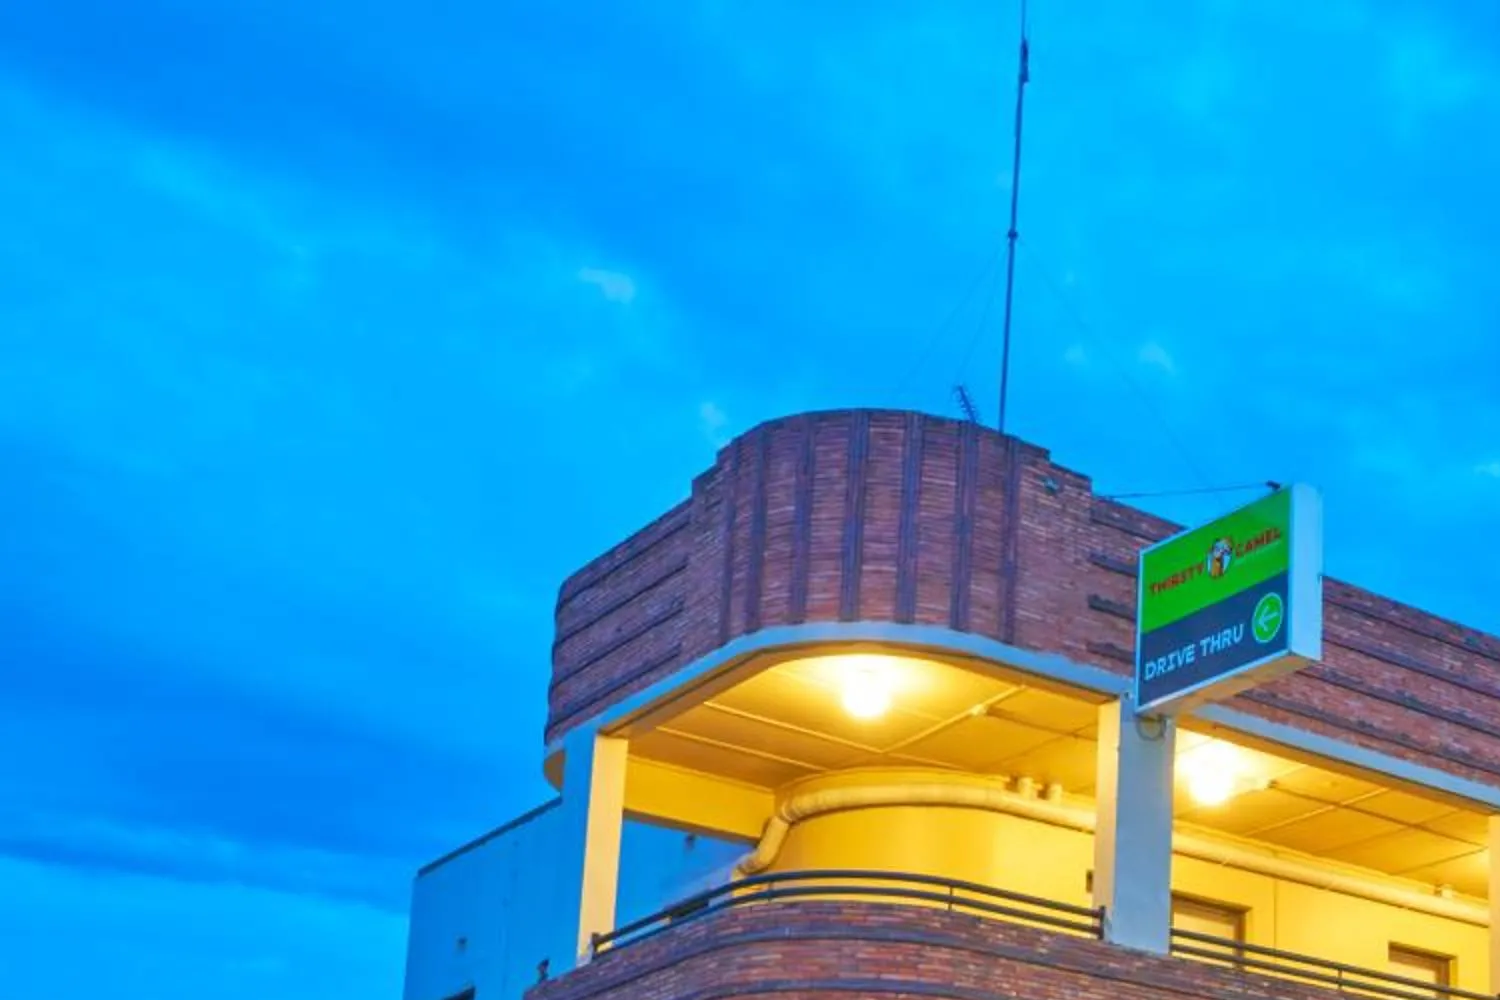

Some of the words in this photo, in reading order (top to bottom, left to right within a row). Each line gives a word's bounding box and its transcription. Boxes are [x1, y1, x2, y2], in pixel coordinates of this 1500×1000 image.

[1150, 562, 1204, 595] THIRSTY
[1144, 643, 1196, 681] DRIVE
[1199, 623, 1245, 657] THRU
